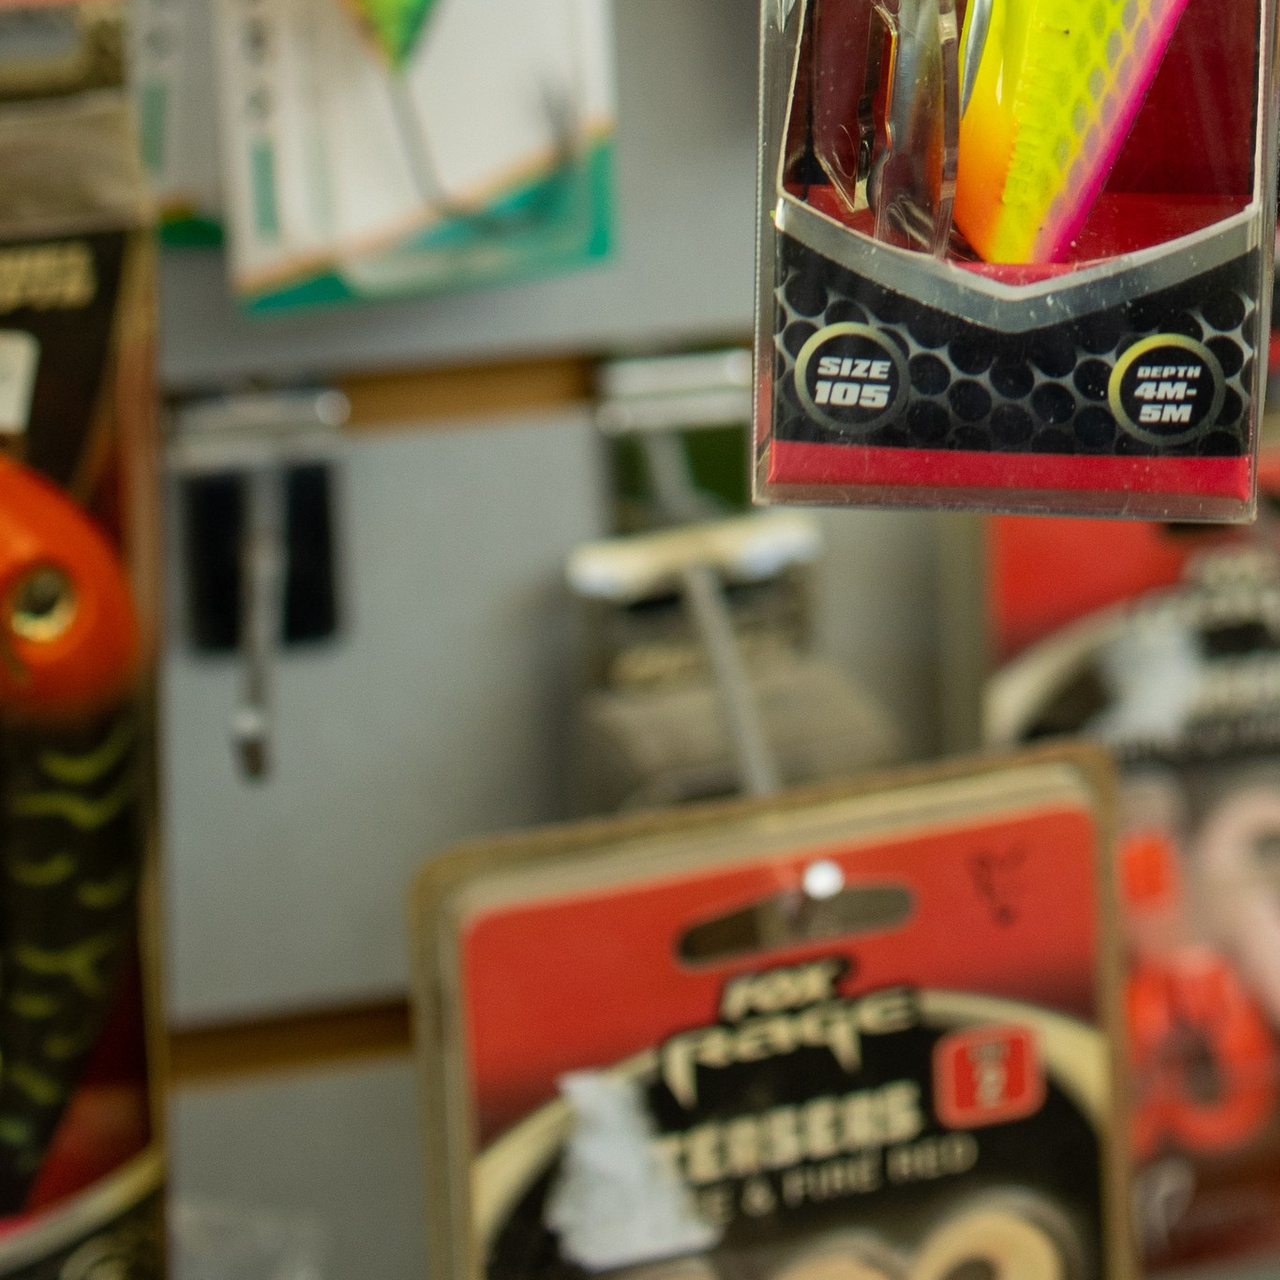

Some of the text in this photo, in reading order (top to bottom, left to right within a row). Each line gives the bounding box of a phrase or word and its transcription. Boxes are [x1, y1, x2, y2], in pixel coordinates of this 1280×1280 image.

[817, 355, 892, 381] SIZE
[1136, 364, 1202, 381] DEPTH
[814, 381, 890, 409] 105
[1133, 381, 1198, 402] 4M-
[1138, 404, 1192, 424] 5M
